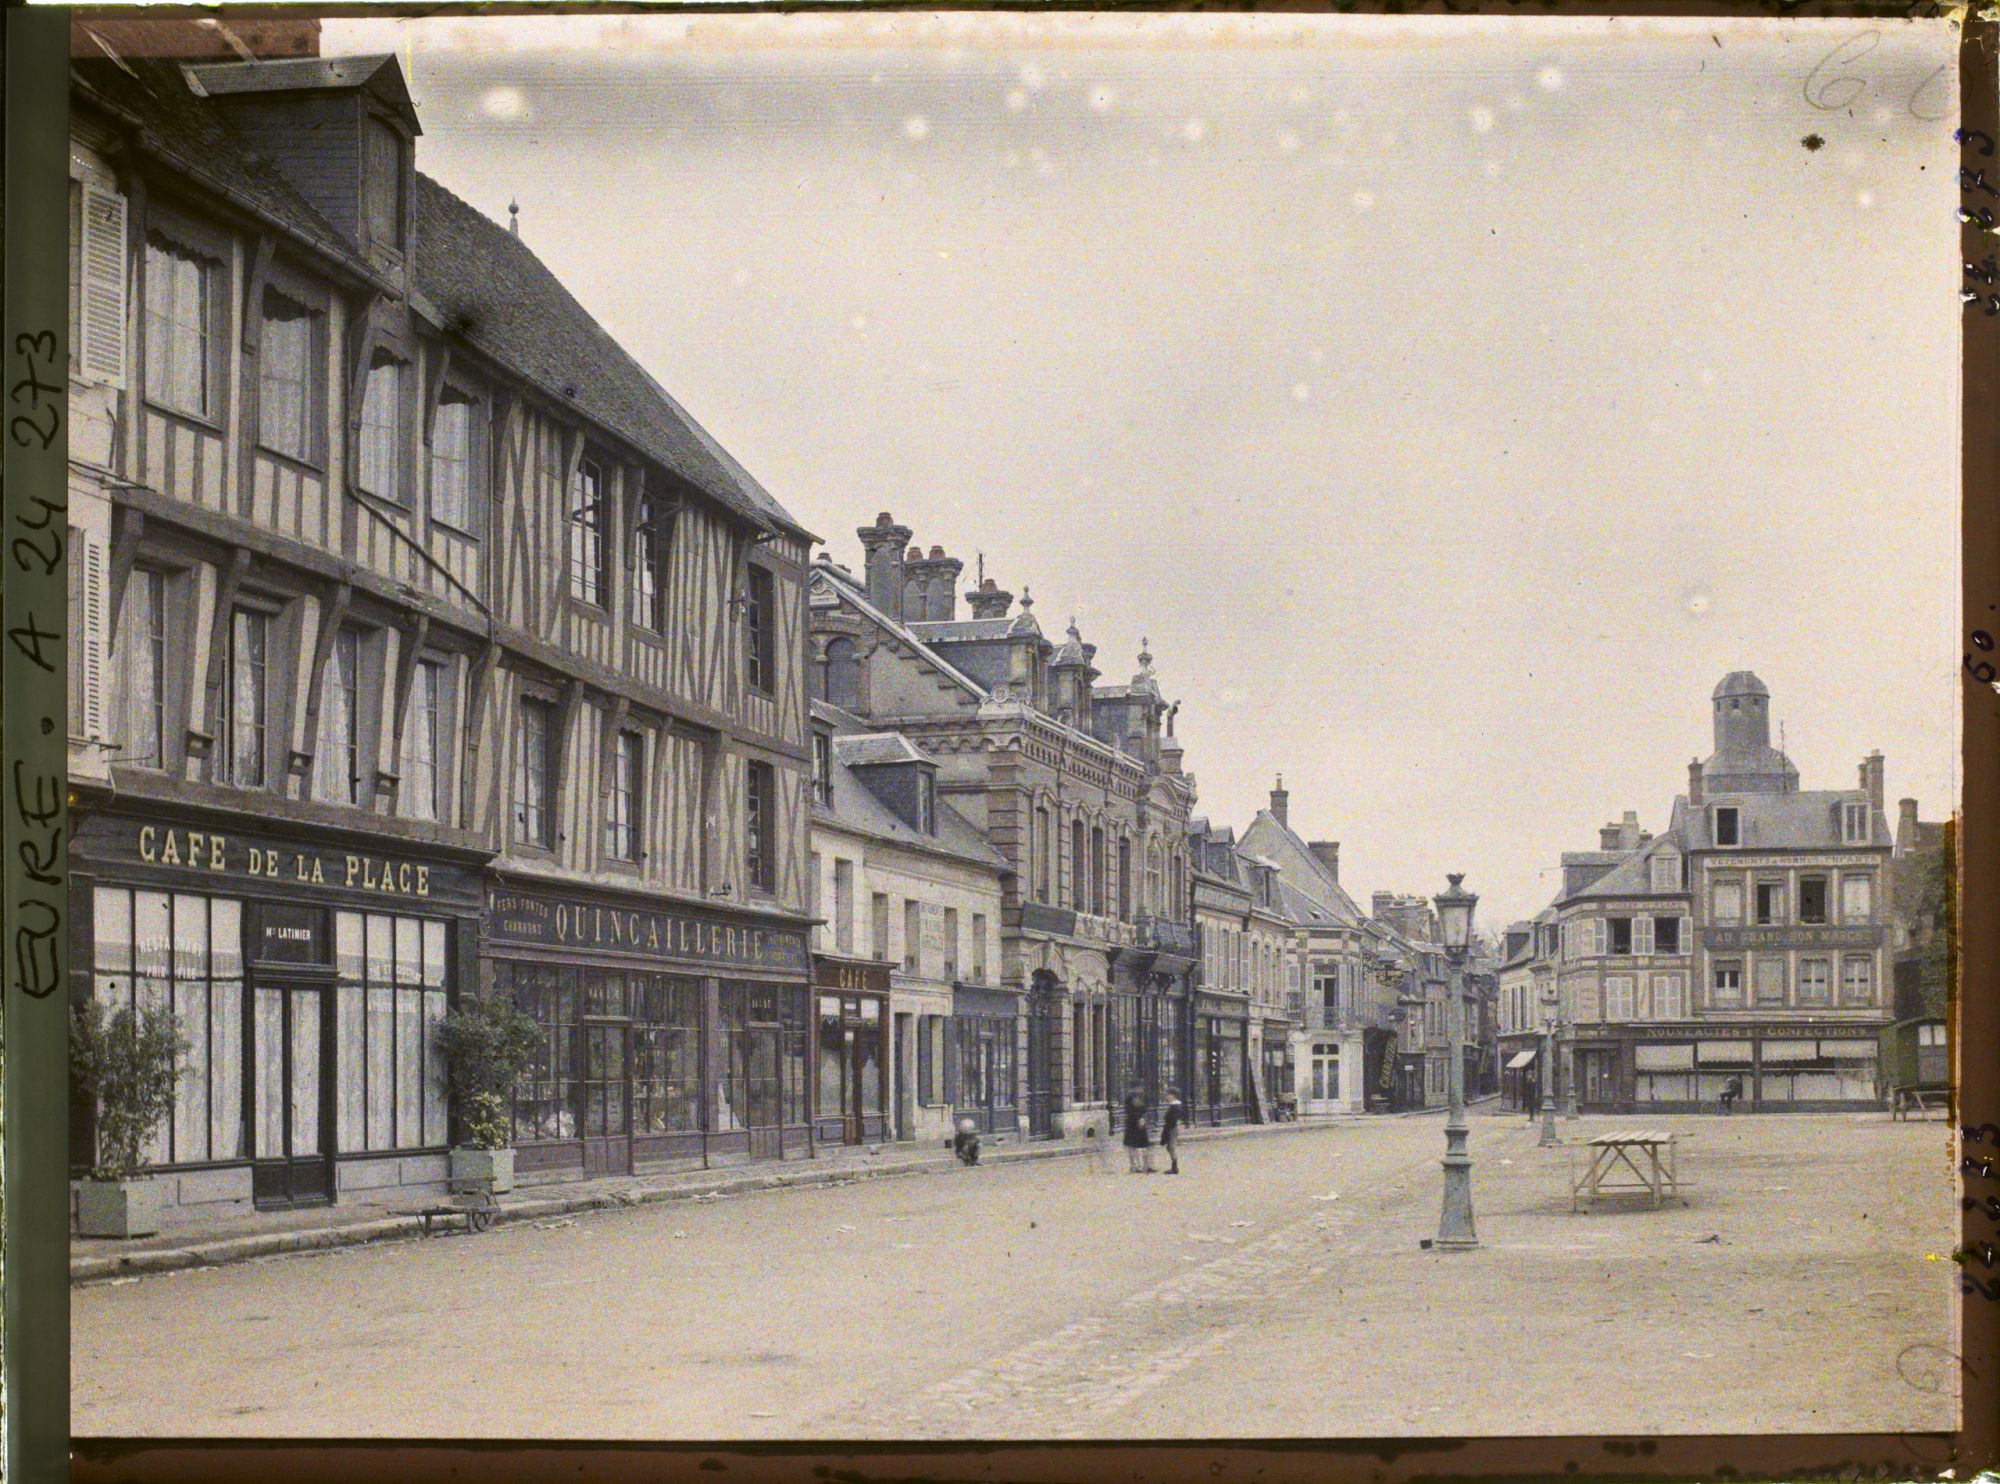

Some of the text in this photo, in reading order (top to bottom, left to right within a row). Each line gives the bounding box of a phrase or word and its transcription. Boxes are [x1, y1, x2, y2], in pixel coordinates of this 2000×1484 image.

[11, 329, 59, 450] 273
[12, 496, 67, 574] 24
[11, 611, 62, 673] A
[138, 825, 431, 897] CAFE DE LA PLACE
[555, 903, 764, 961] QUINCAILLERIE
